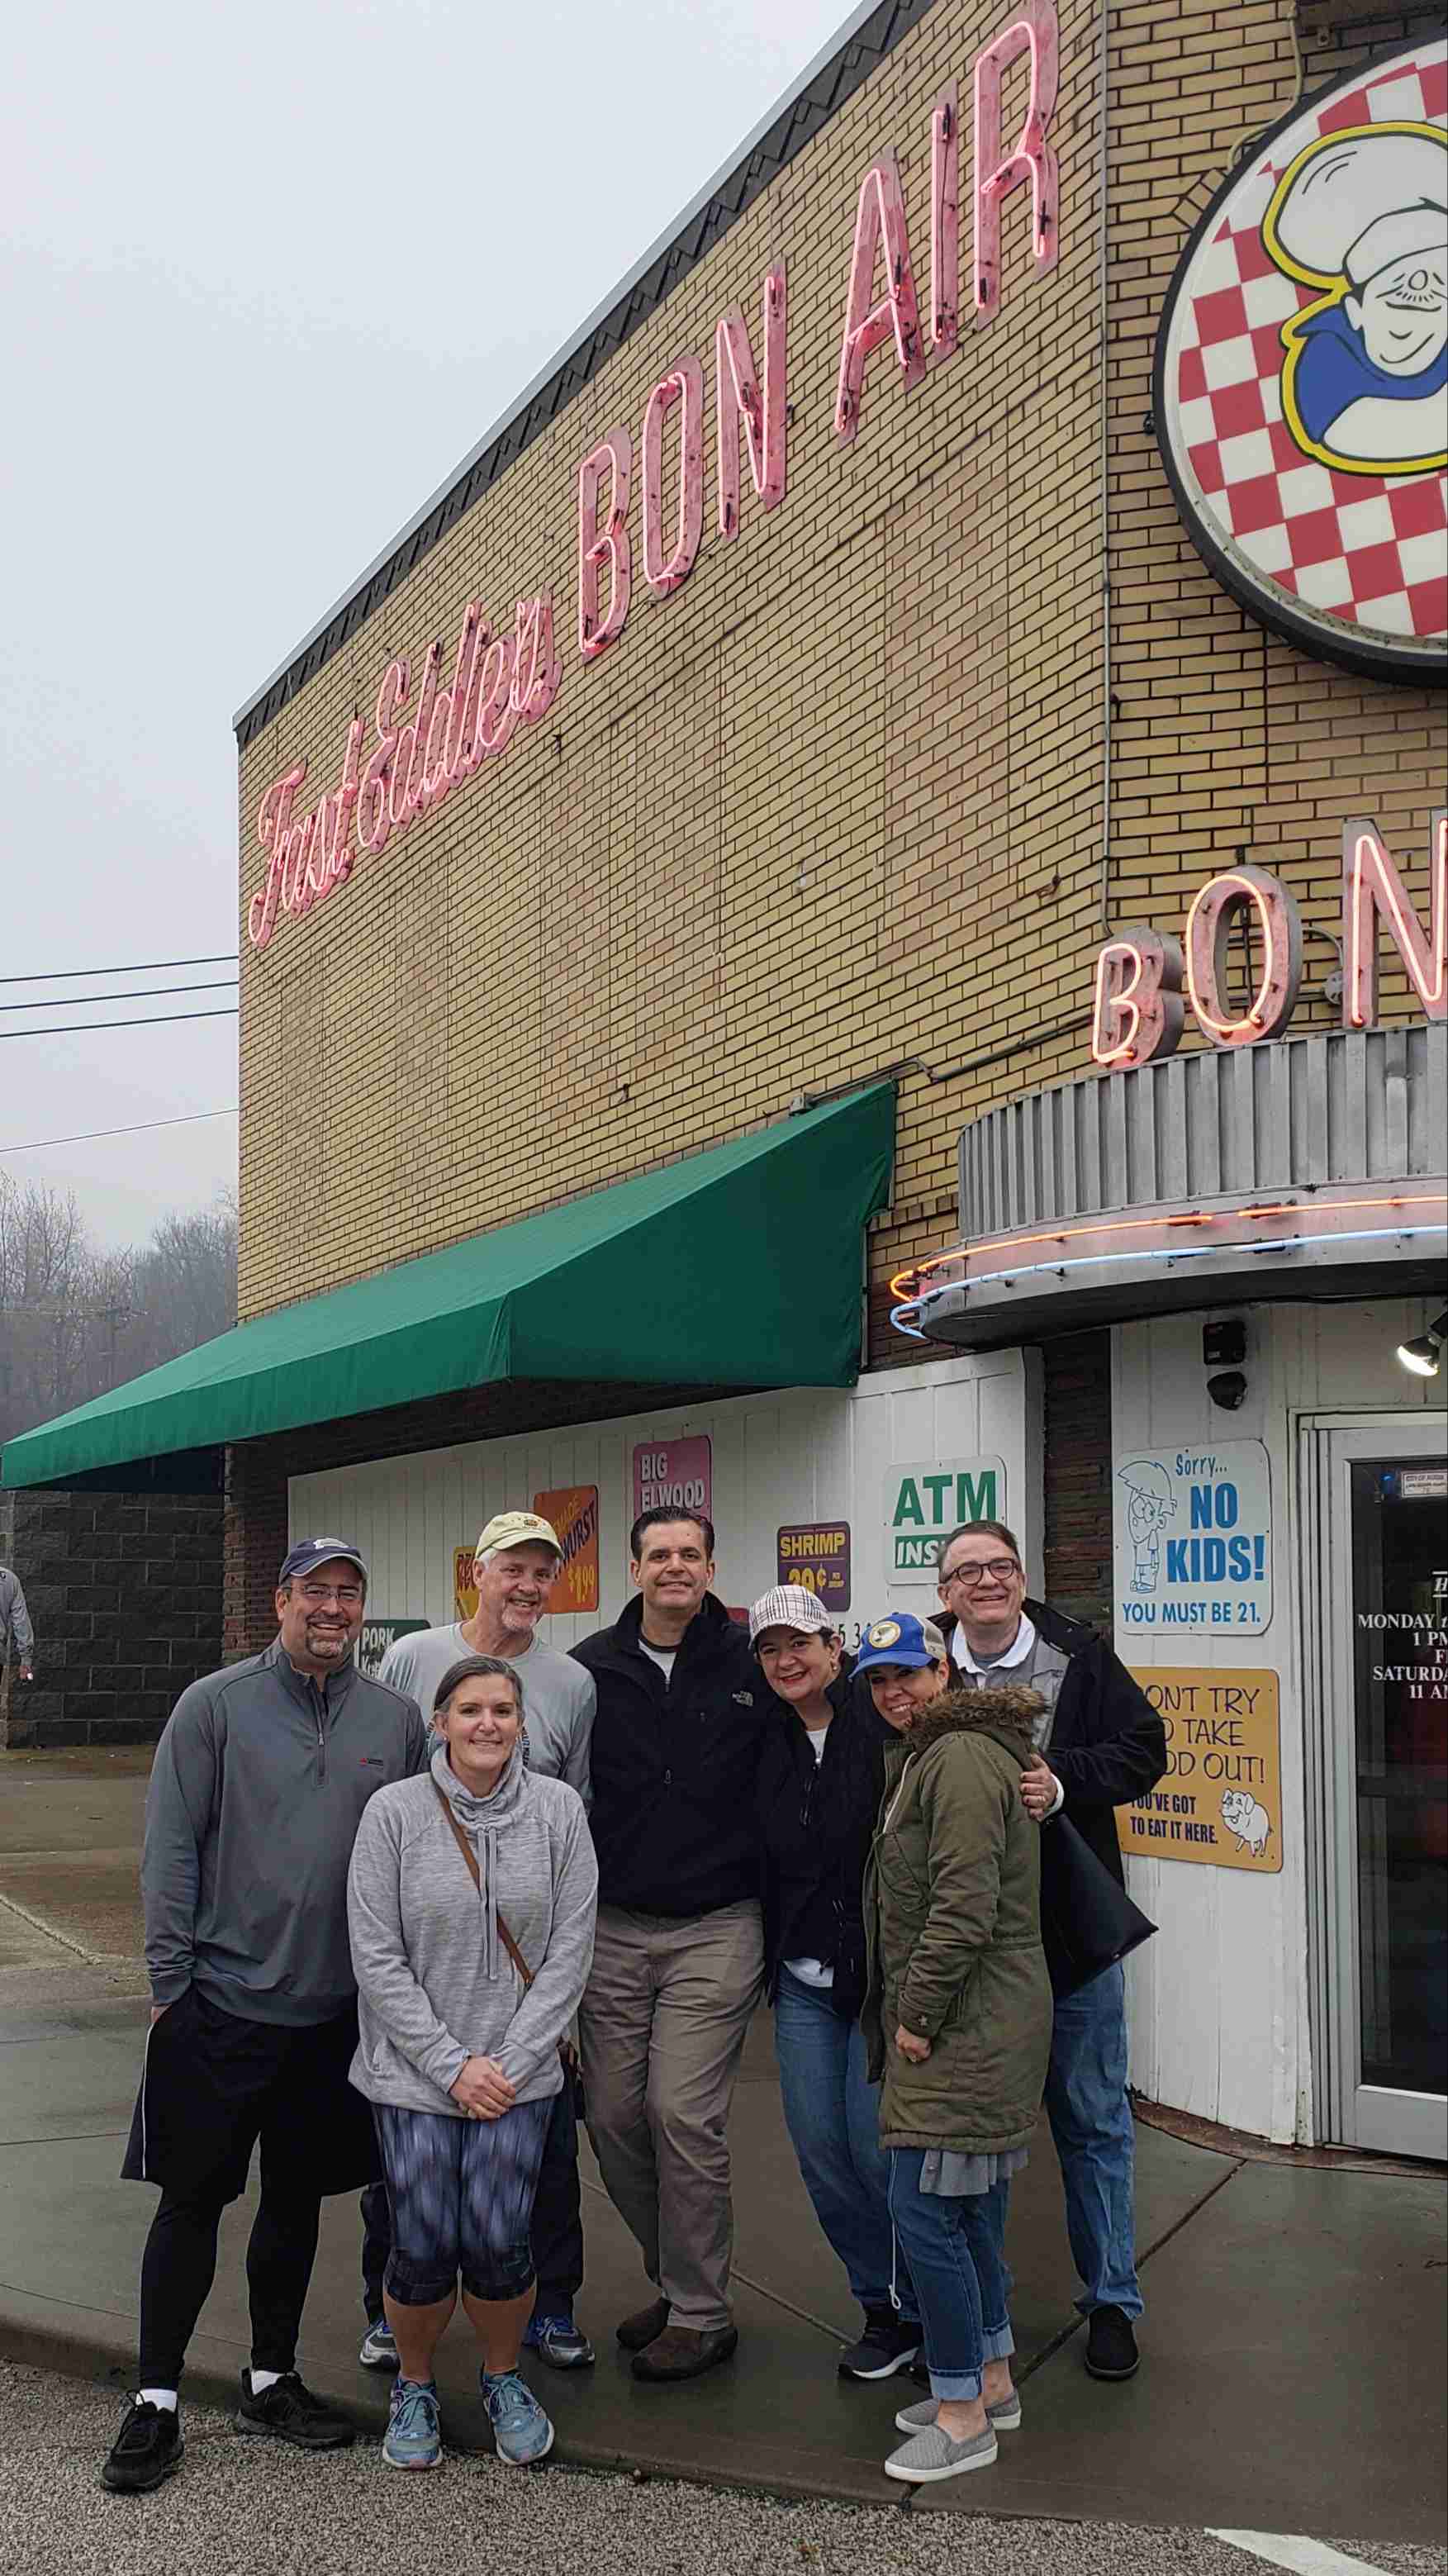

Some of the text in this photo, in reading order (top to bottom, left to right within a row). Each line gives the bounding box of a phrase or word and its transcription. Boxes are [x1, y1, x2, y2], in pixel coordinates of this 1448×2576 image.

[249, 715, 364, 948] Fast
[579, 257, 786, 663] BON
[834, 0, 1059, 450] AIR
[1092, 809, 1448, 1069] BON
[641, 1452, 667, 1483] BIG
[1175, 1454, 1227, 1477] Sorry...
[641, 1478, 705, 1514] ELWOOD
[892, 1471, 996, 1527] ATM
[1190, 1482, 1238, 1530] NO
[780, 1533, 846, 1557] SHRIMP
[897, 1539, 946, 1566] INS
[1166, 1535, 1265, 1584] KIDS!
[1123, 1602, 1260, 1623] YOU MUST BE 21.
[1358, 1614, 1435, 1628] MONDAY
[362, 1627, 395, 1652] PORK
[1413, 1631, 1421, 1646] 1
[1145, 1684, 1260, 1715] ON'T TRY
[1182, 1719, 1245, 1746] TAKE
[1204, 1752, 1265, 1783] OUT!
[1173, 1794, 1197, 1815] GOT
[1130, 1816, 1219, 1844] TO EAT IT HERE.
